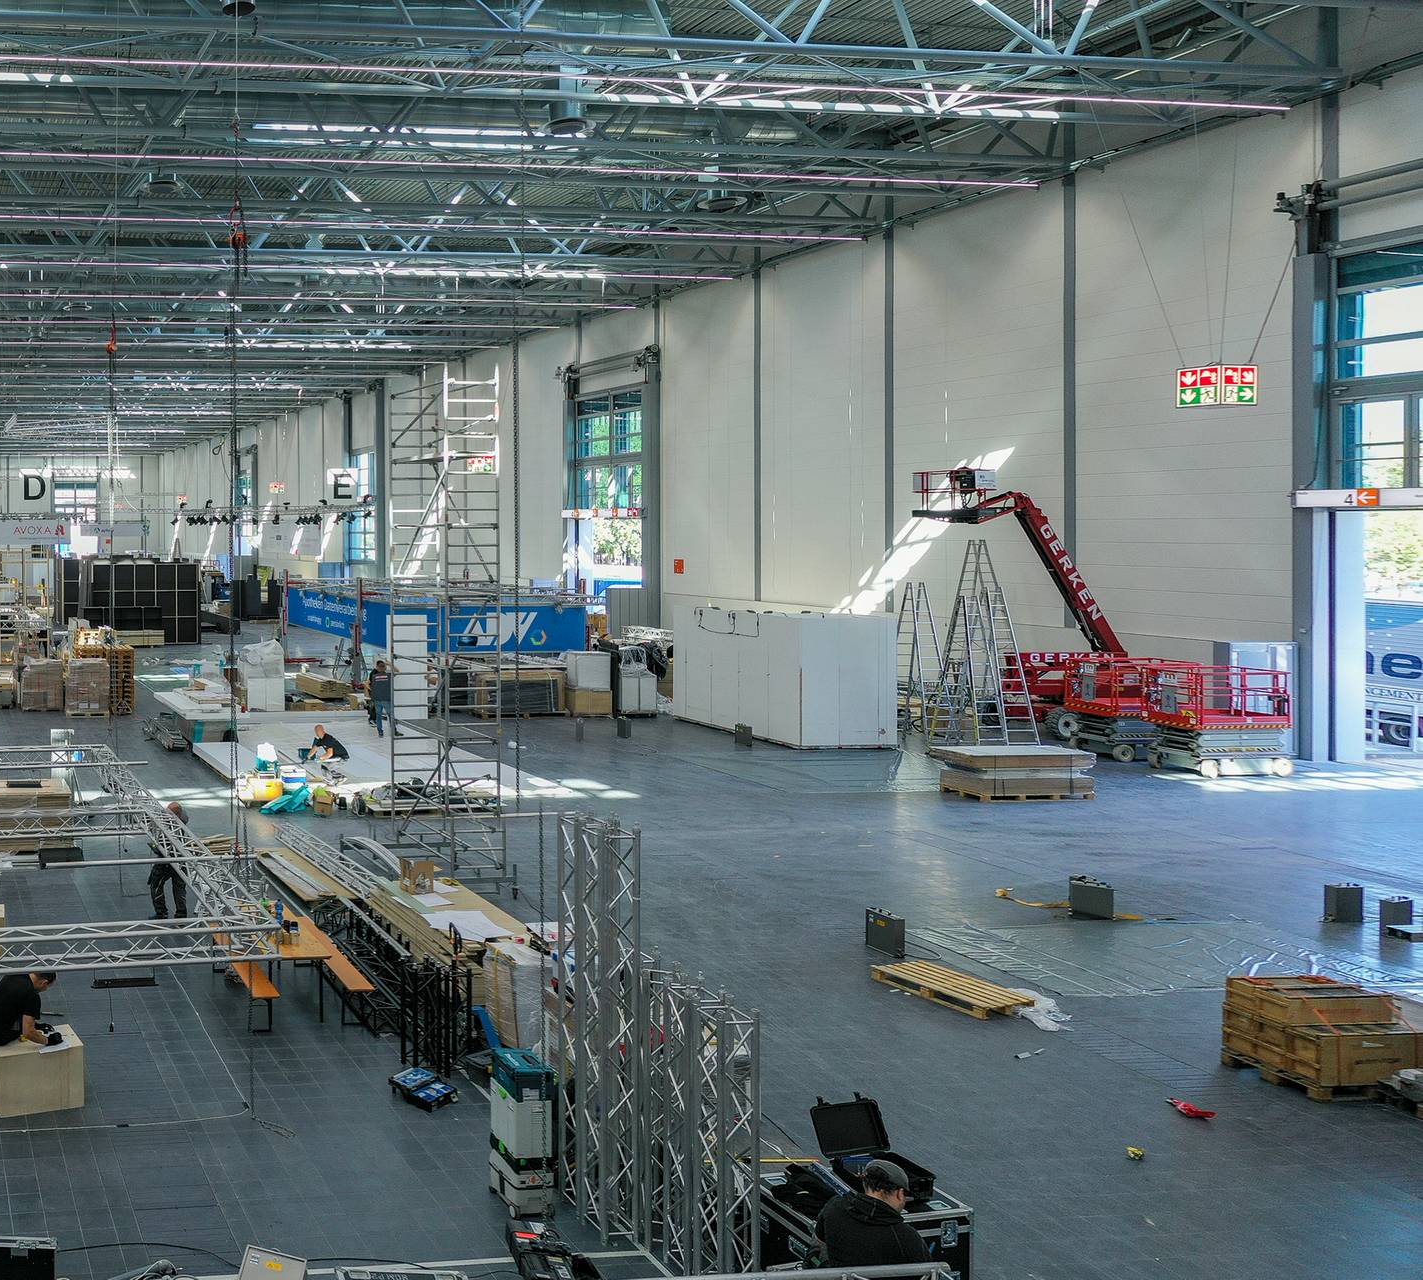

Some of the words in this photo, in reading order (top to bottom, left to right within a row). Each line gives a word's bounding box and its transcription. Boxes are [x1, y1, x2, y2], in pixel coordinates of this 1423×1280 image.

[23, 474, 46, 501] D
[334, 473, 352, 499] E
[1344, 493, 1353, 505] 4
[13, 525, 52, 535] AVOXA
[1039, 523, 1103, 621] GERKEN
[1366, 651, 1423, 679] e
